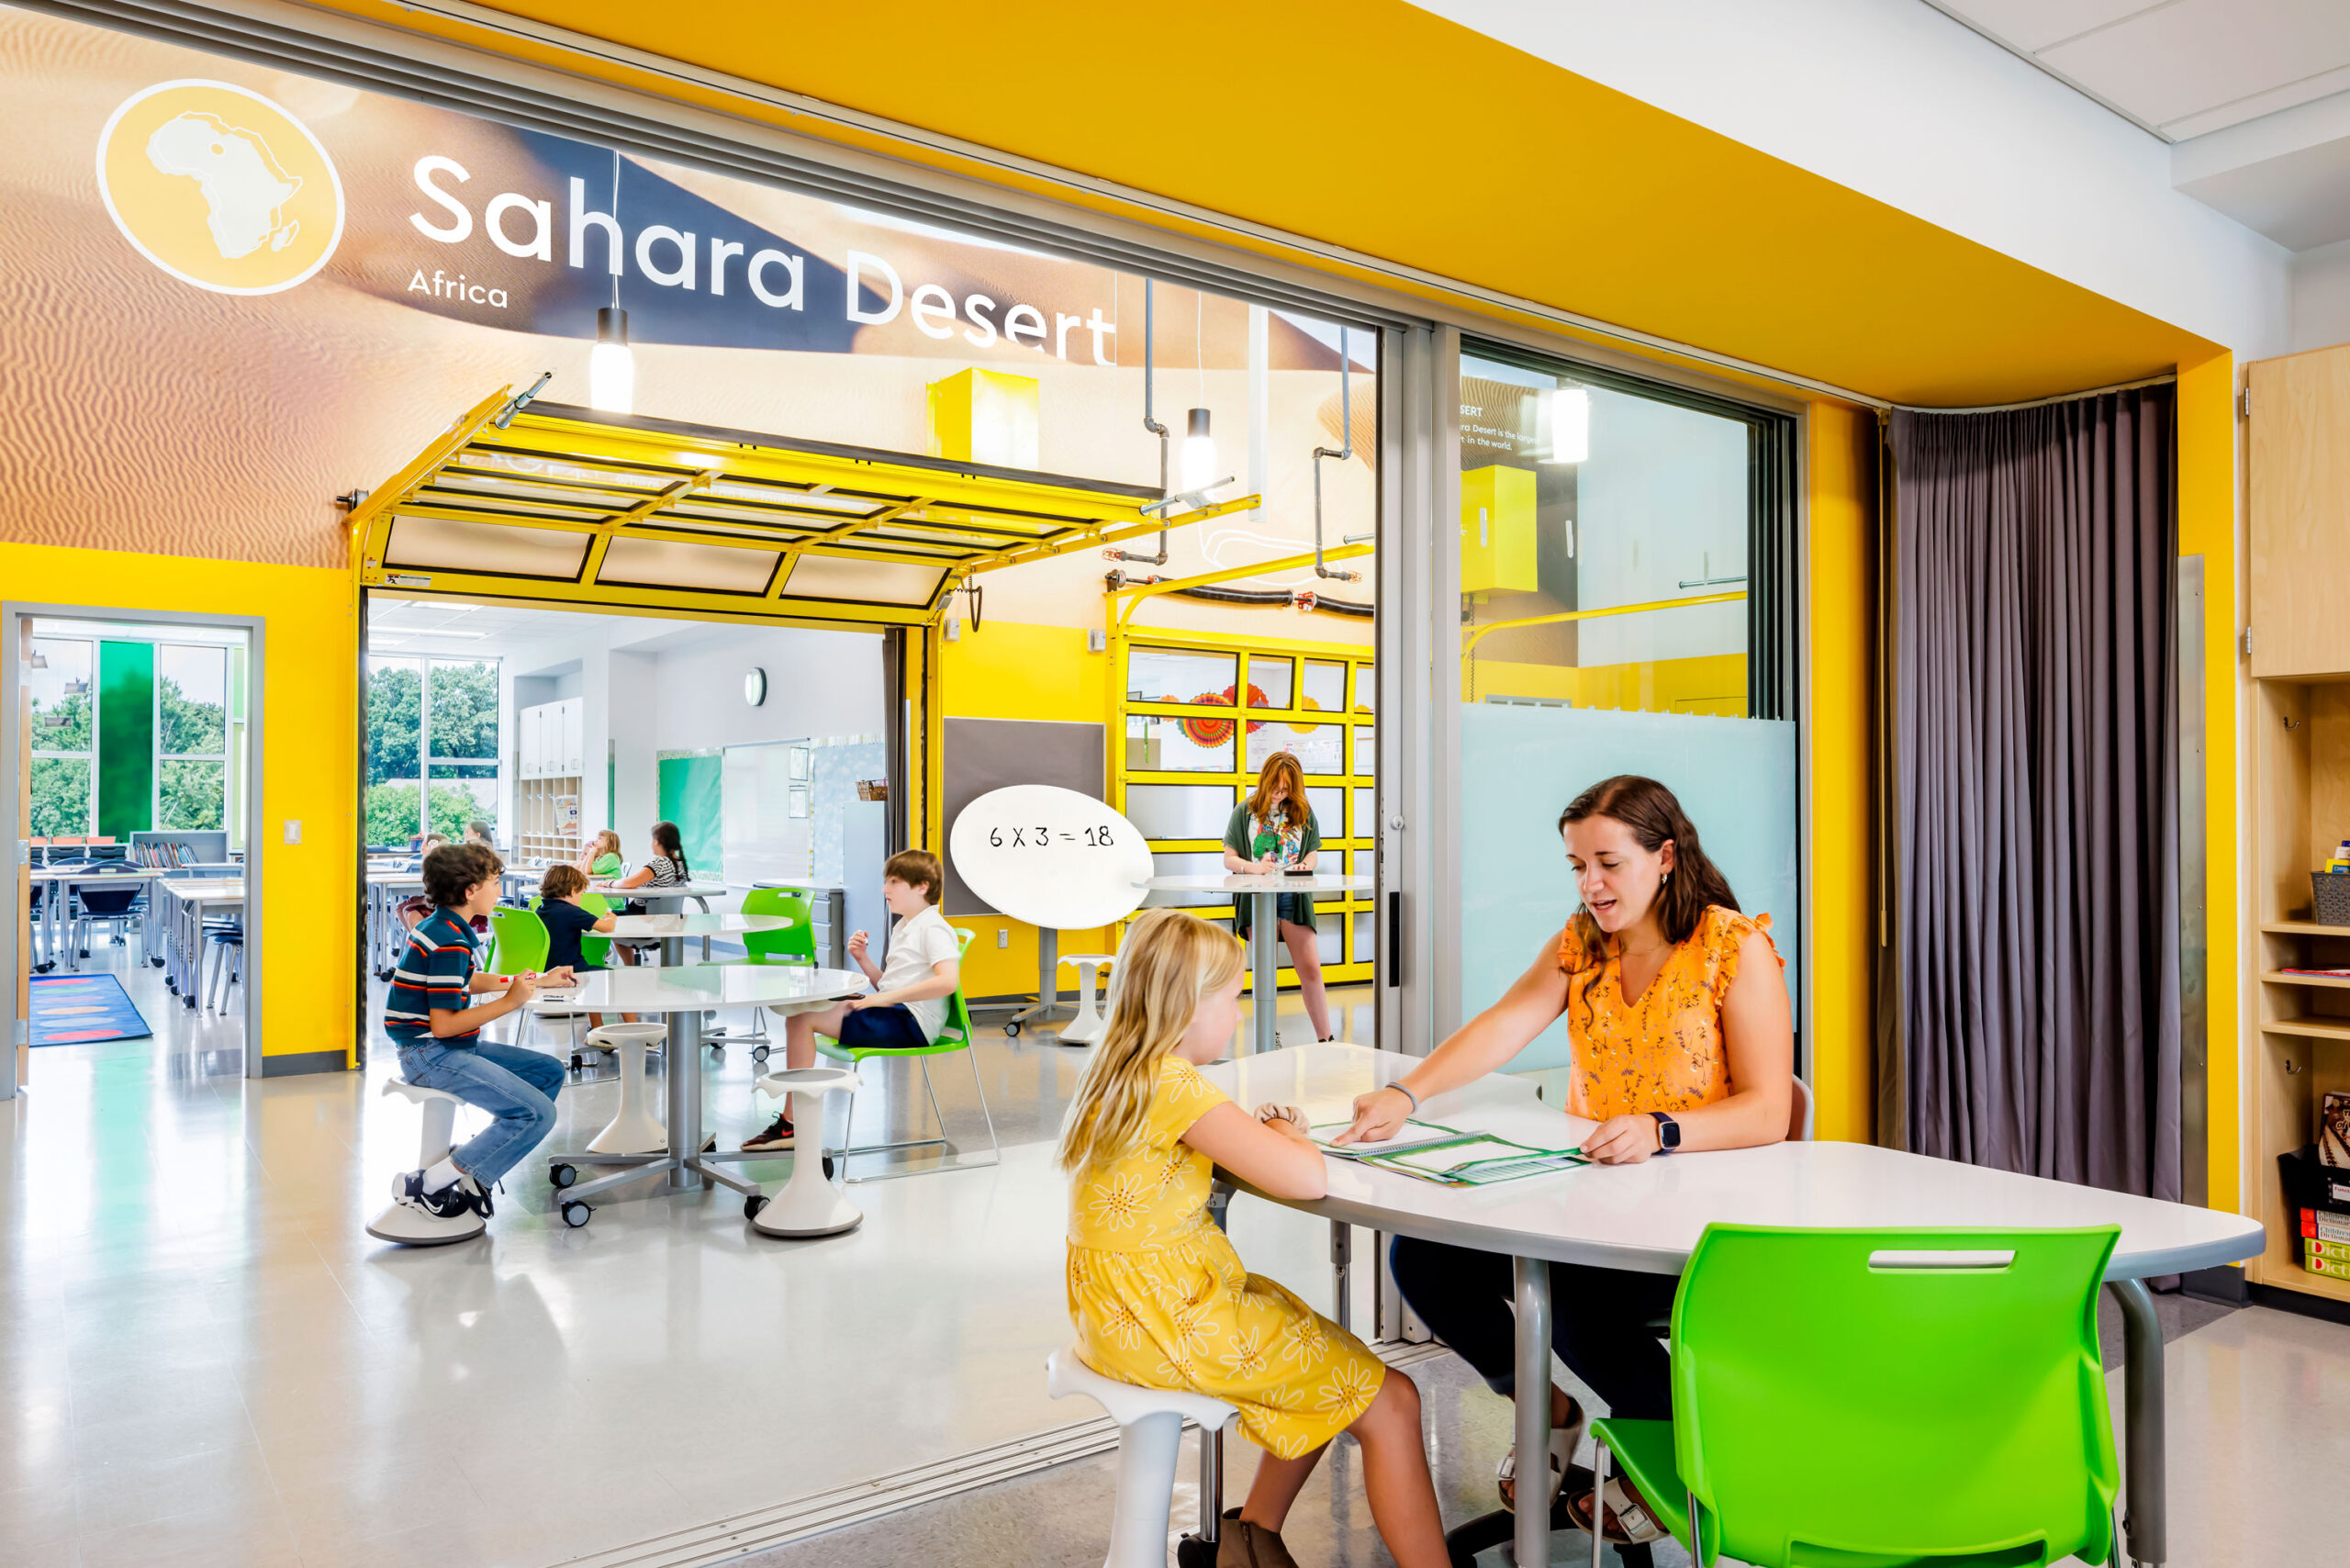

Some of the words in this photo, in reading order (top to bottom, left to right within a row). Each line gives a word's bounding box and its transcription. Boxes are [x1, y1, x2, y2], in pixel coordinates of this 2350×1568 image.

[409, 155, 804, 311] Sahara
[846, 249, 1117, 367] Desert
[408, 268, 508, 308] Africa
[1460, 405, 1483, 417] SERT
[1473, 425, 1496, 436] Desert
[1498, 429, 1504, 437] is
[1505, 431, 1516, 440] the
[1467, 434, 1475, 444] in
[1477, 437, 1491, 447] the
[1492, 442, 1513, 451] world.
[990, 826, 1002, 847] 6
[1035, 826, 1049, 846] 3
[1084, 825, 1113, 846] 18
